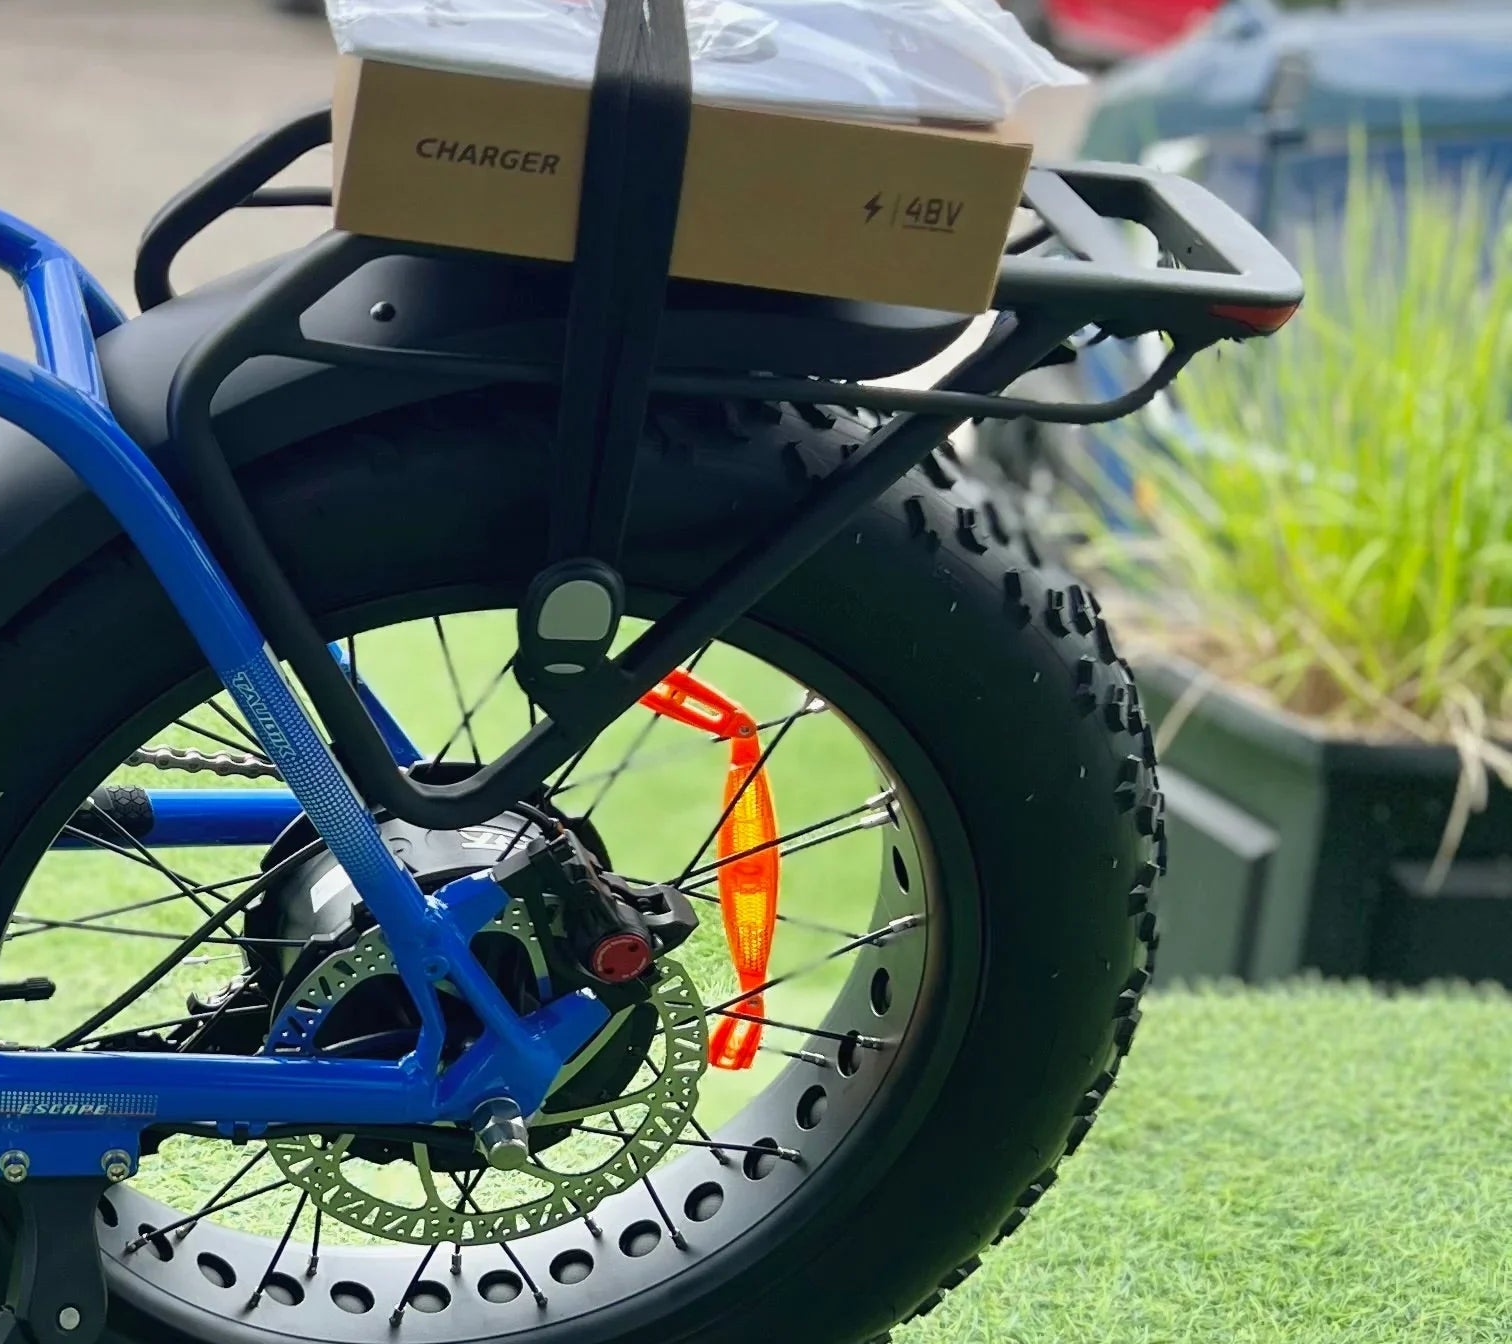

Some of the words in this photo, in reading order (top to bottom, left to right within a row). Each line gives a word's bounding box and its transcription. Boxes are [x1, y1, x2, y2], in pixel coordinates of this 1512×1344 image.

[415, 137, 561, 175] CHARGER
[905, 196, 964, 227] 48V
[19, 1102, 109, 1116] ESCAPE
